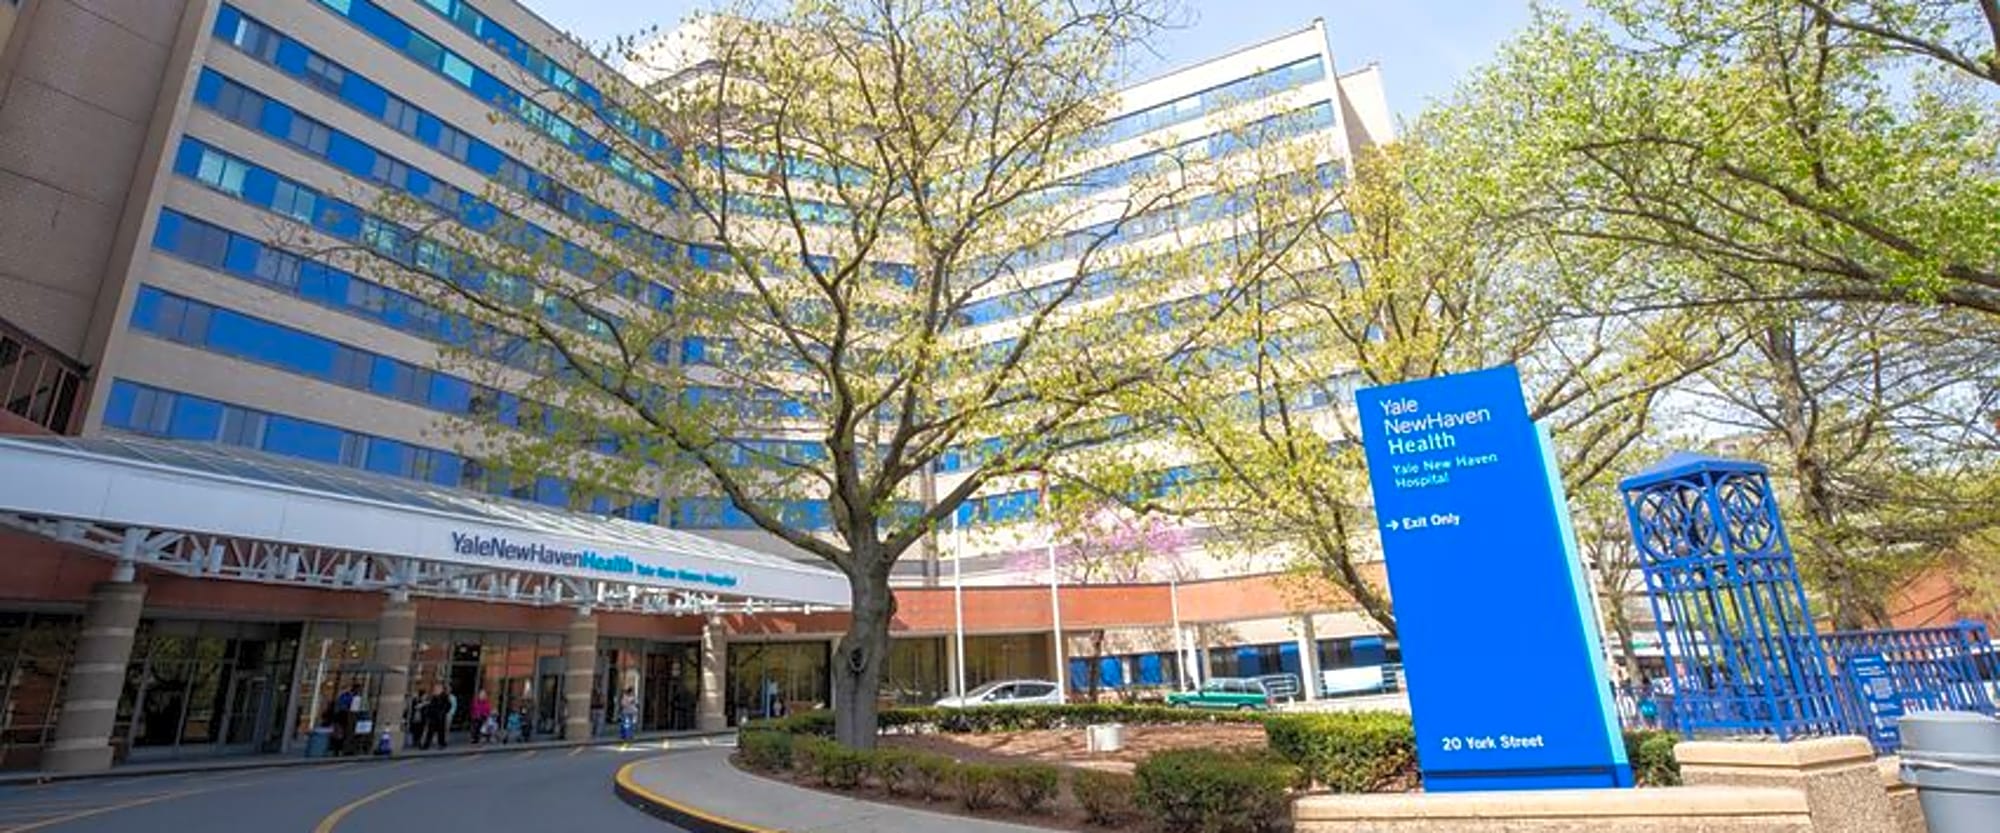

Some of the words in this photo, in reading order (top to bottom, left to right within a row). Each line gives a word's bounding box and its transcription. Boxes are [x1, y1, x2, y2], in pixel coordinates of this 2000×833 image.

[1379, 398, 1418, 416] Yale
[1384, 408, 1491, 436] NewHaven
[1388, 431, 1456, 455] Health
[1393, 463, 1419, 475] Yale
[1423, 460, 1451, 471] New
[1455, 453, 1498, 466] Haven
[1395, 472, 1449, 488] Hospital
[1402, 517, 1427, 529] Exit
[1430, 513, 1460, 526] Only
[452, 532, 633, 573] YaleNewHavenHealth
[1442, 737, 1462, 751] 20
[1466, 736, 1496, 749] York
[1500, 734, 1544, 748] Street
